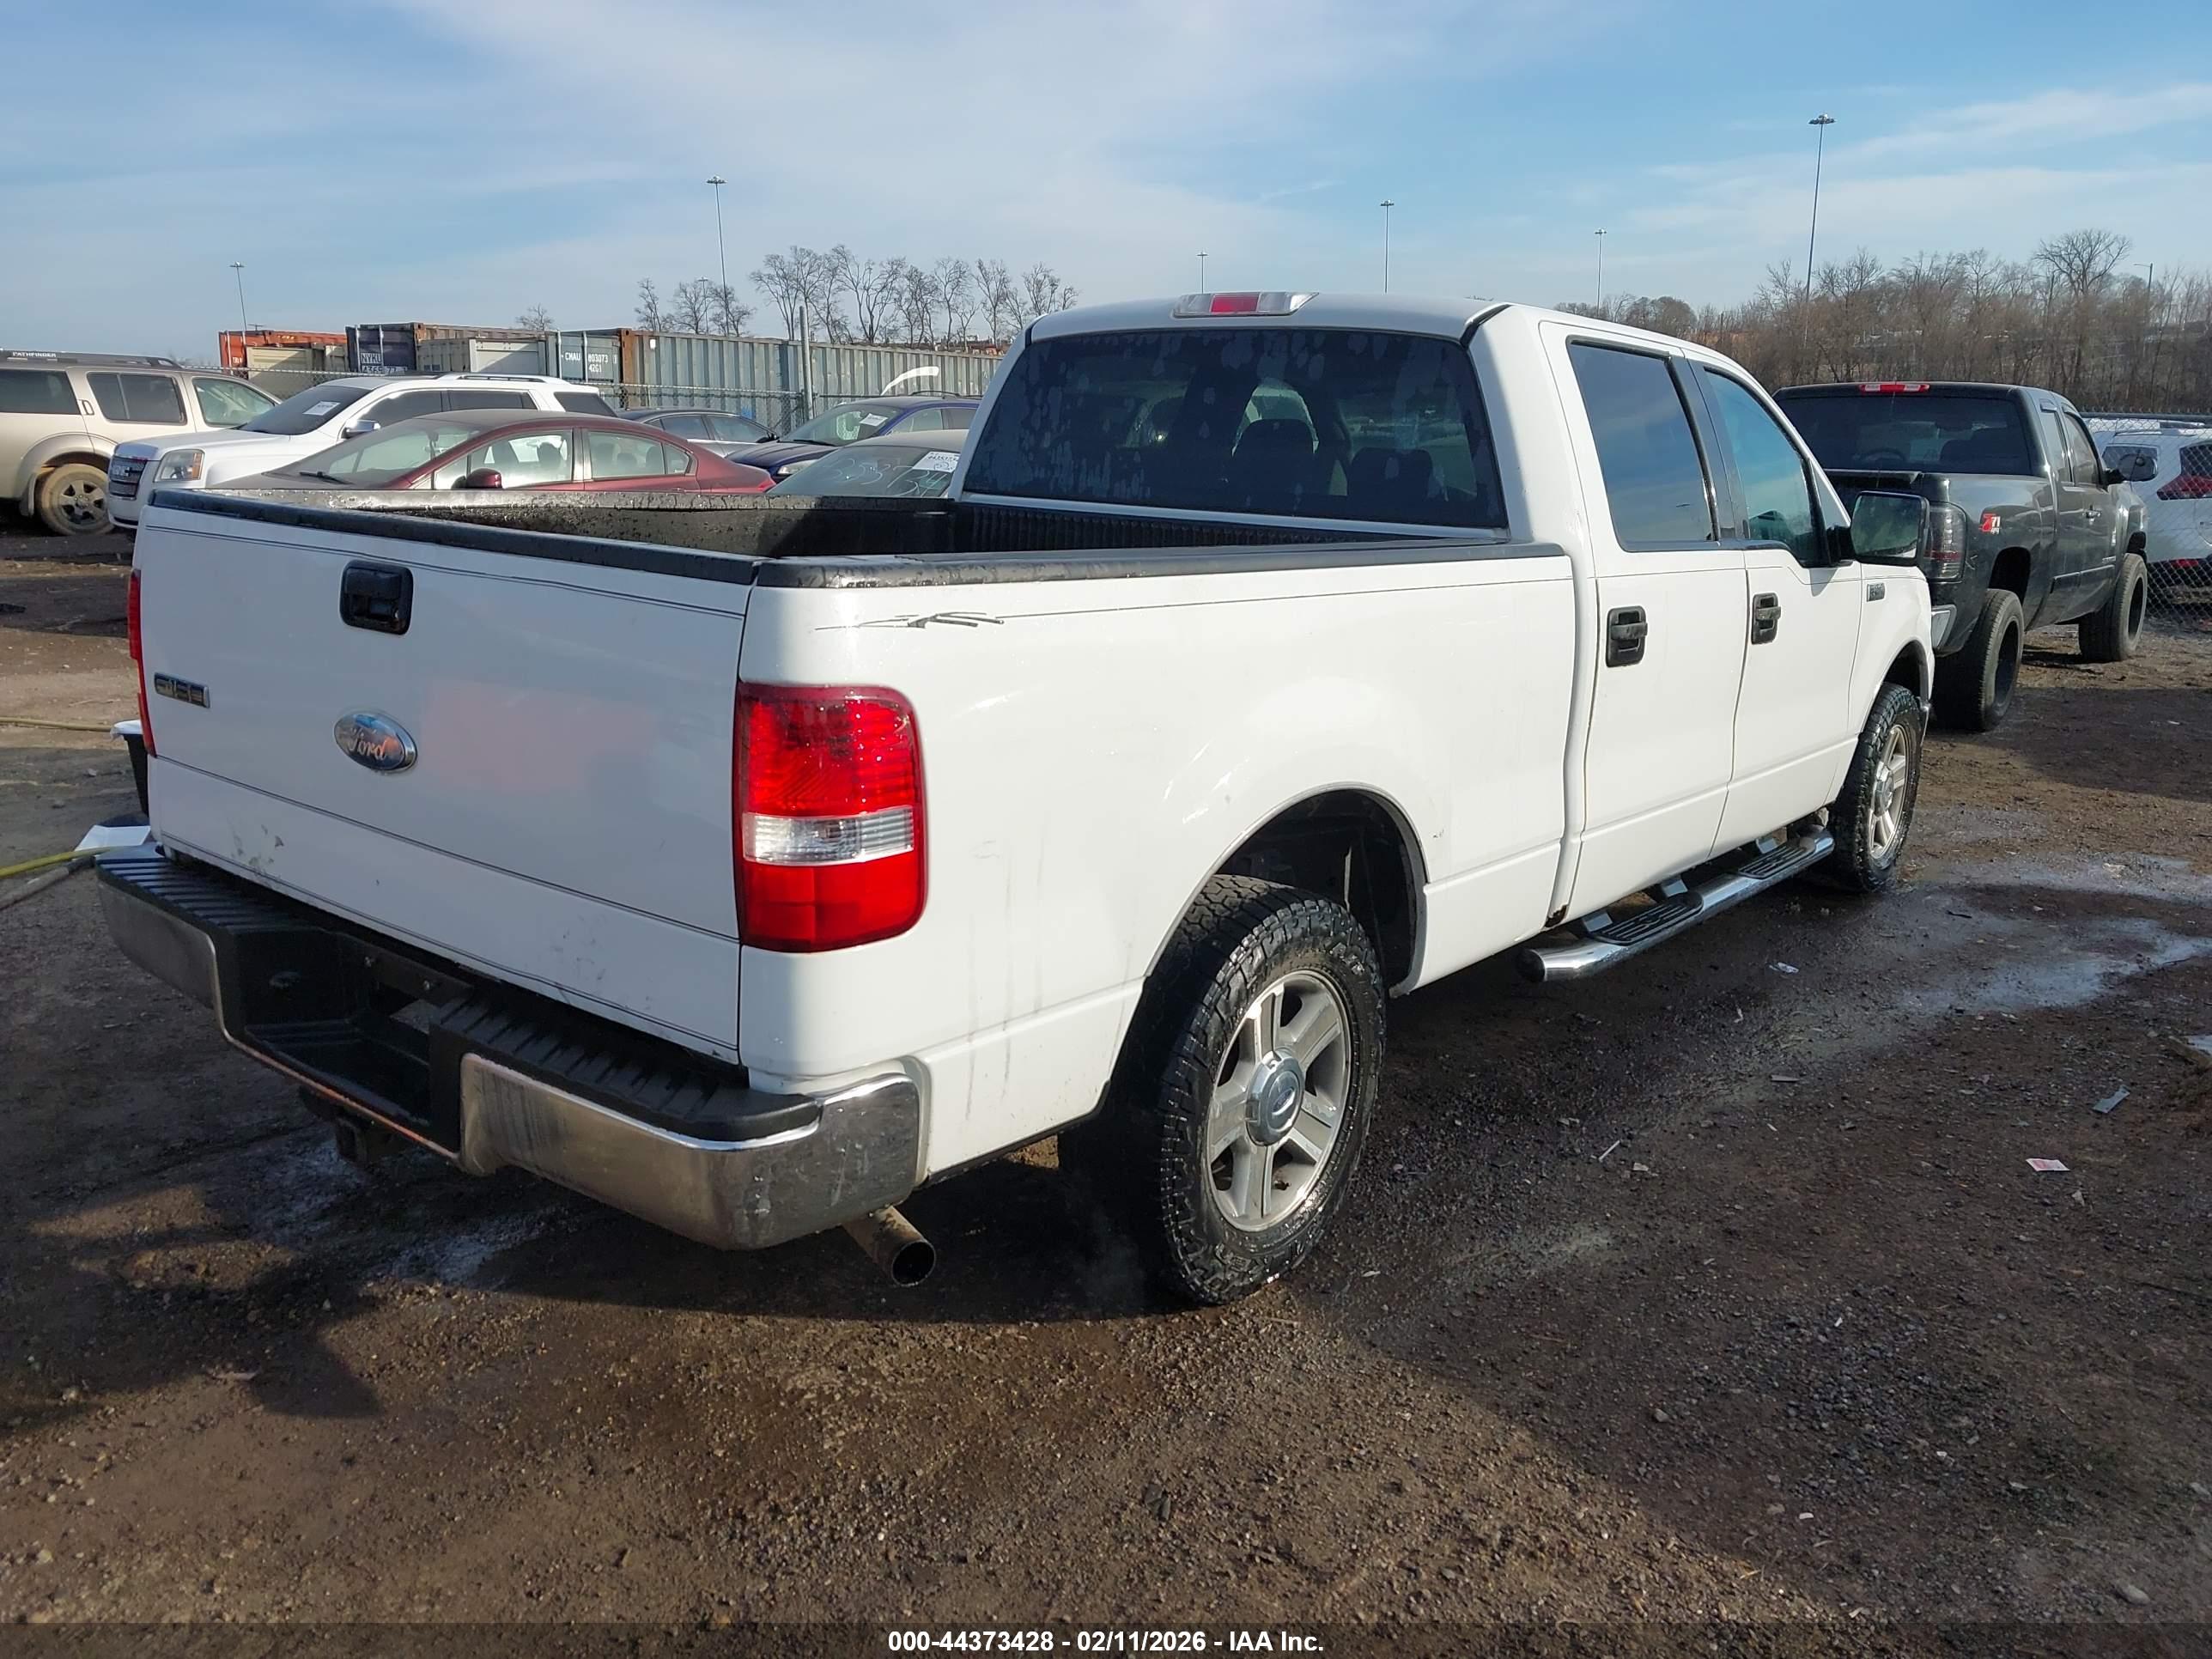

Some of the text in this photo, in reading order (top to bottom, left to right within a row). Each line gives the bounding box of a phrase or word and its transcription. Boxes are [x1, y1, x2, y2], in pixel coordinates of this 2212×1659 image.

[361, 352, 383, 364] NYKU
[564, 352, 581, 361] CMAU
[340, 726, 387, 762] Ford
